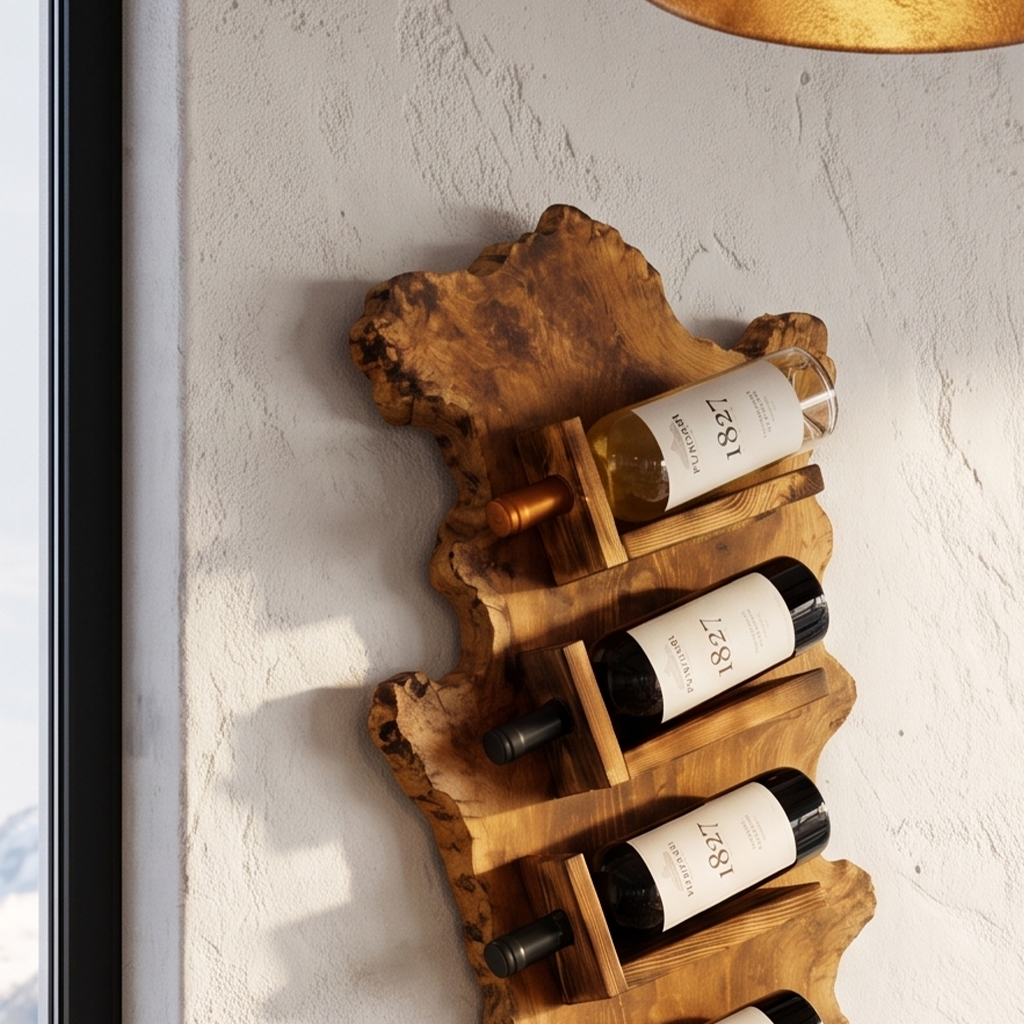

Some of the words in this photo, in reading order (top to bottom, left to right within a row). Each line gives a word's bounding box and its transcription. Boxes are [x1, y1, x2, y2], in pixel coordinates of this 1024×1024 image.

[705, 398, 742, 460] 1827
[699, 617, 734, 678] 1827
[696, 822, 735, 879] 1827
